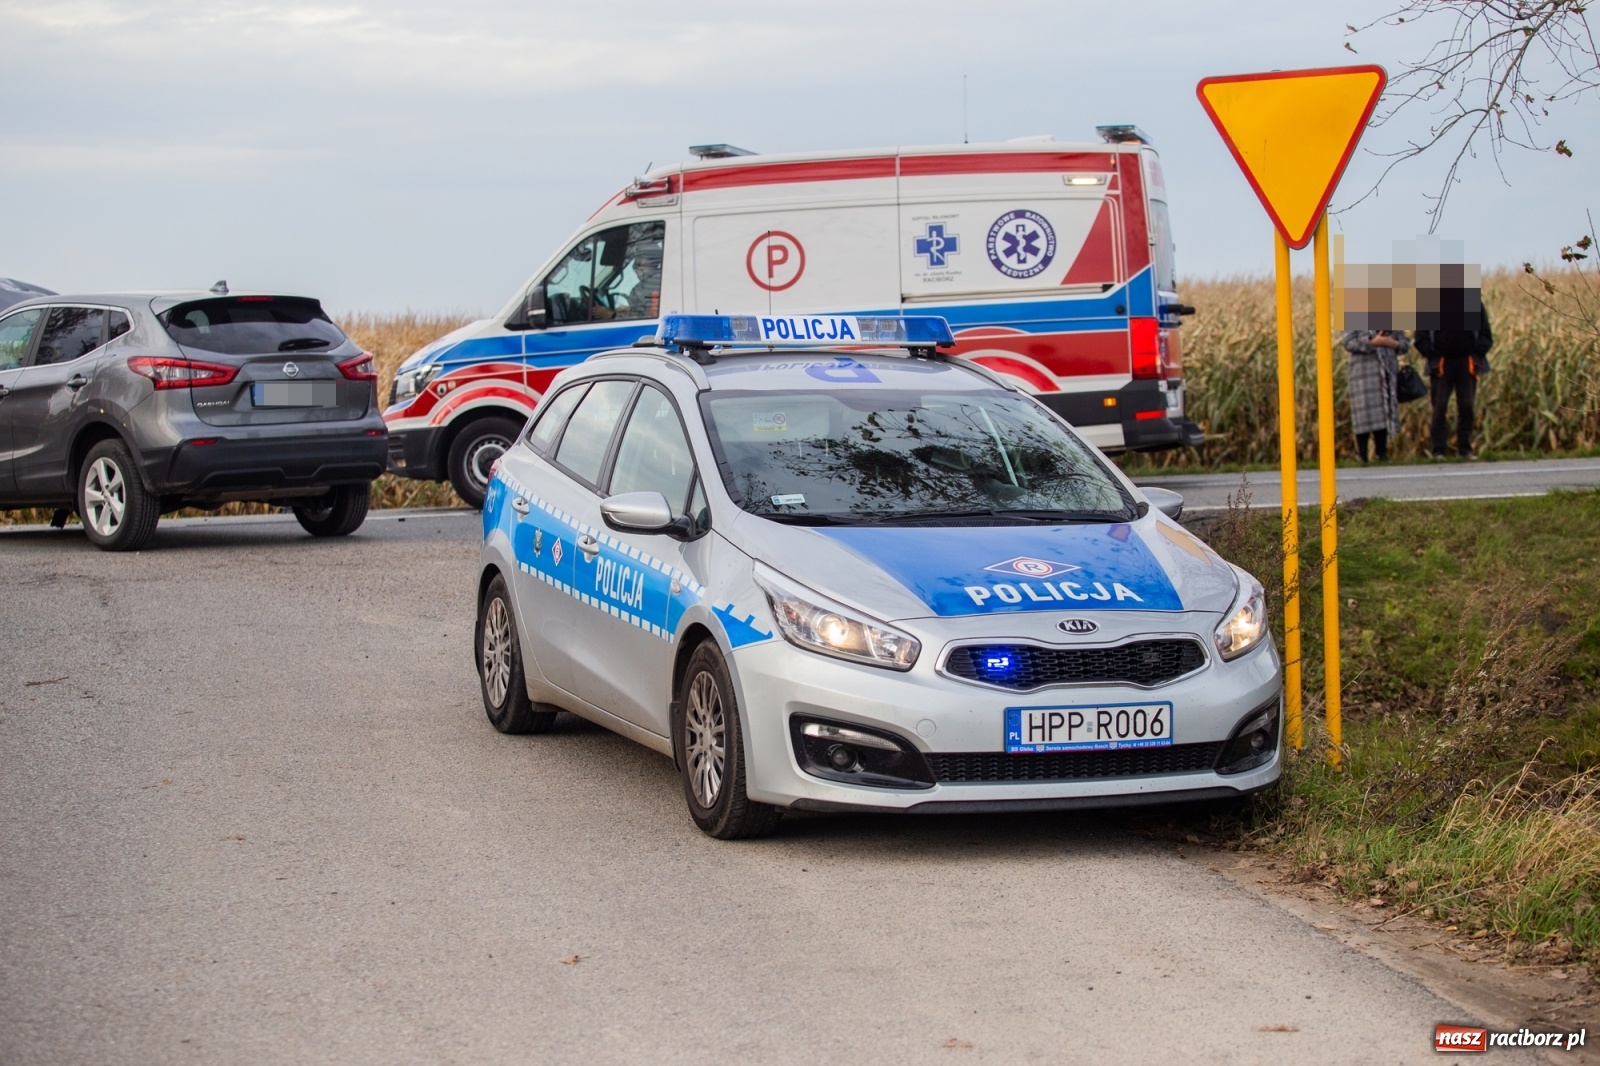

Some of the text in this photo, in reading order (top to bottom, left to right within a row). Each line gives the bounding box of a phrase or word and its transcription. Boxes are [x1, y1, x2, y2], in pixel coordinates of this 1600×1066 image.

[1025, 211, 1055, 257] RATOWNICTWO
[767, 244, 789, 279] P
[1000, 263, 1045, 278] MEDYCZNE
[761, 317, 856, 341] POLICJA
[595, 555, 644, 612] POLICJA
[964, 581, 1145, 607] POLICJA
[1062, 620, 1094, 632] KIA
[1009, 707, 1165, 742] PL HPP R006
